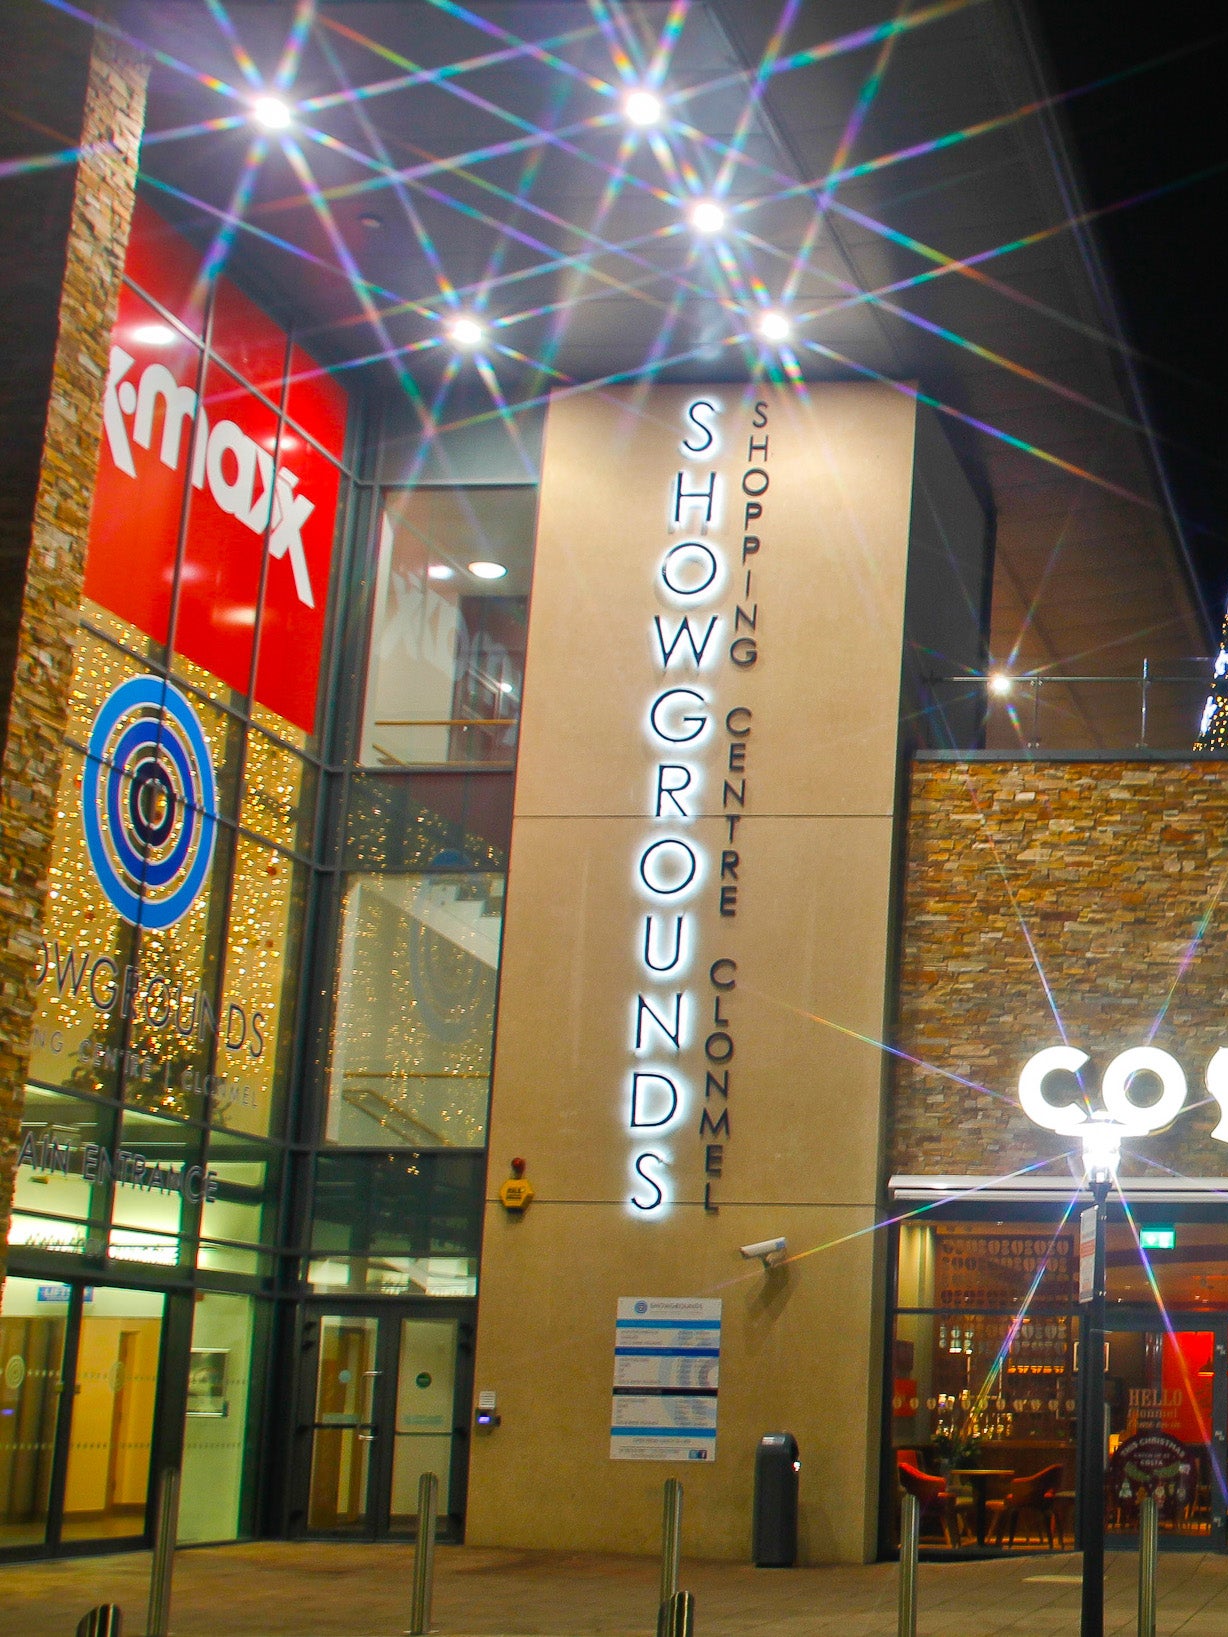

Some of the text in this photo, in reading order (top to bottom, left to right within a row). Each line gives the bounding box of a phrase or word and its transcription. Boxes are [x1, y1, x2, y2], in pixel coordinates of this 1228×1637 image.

[631, 401, 719, 1210] SHOWGROUNDS
[700, 401, 770, 1215] SHOPPING CENTRE CLONMEL
[82, 1143, 219, 1204] ENTRANCE
[1128, 1388, 1183, 1407] HELLO
